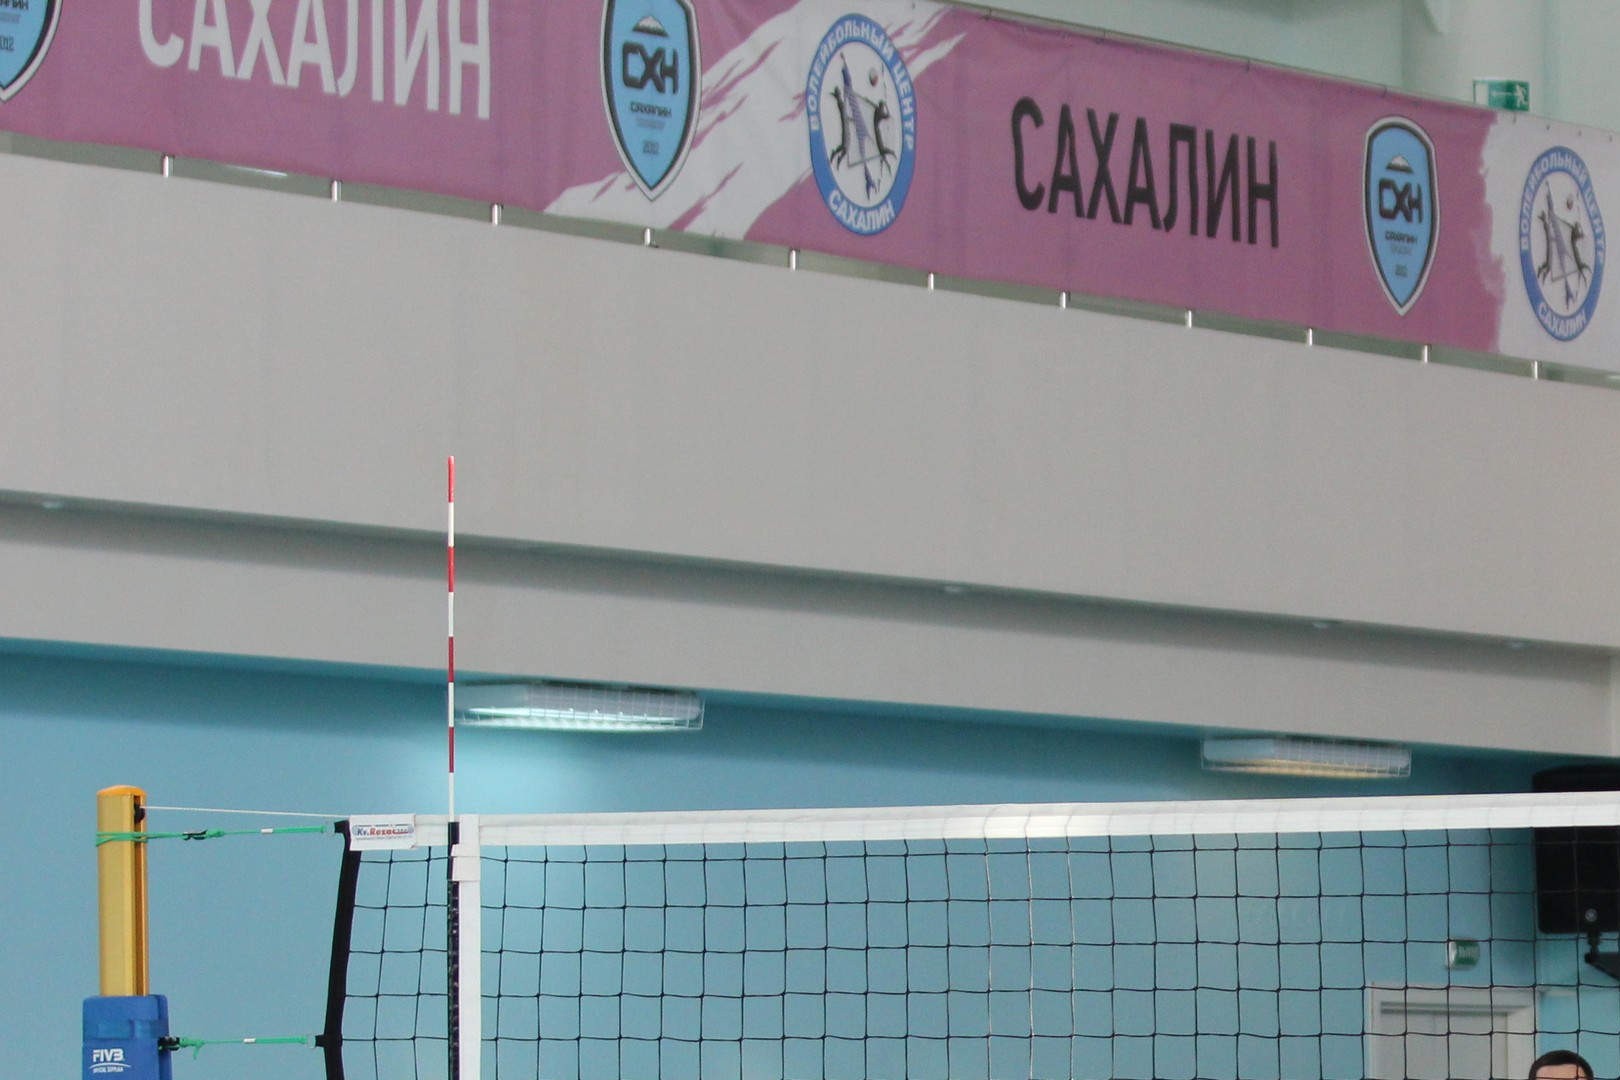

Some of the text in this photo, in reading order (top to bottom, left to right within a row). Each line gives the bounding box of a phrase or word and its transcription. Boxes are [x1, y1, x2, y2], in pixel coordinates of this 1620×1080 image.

[1011, 96, 1279, 248] САХАЛИН
[829, 188, 896, 232] САХАЛИН
[93, 1048, 125, 1063] FIVB
